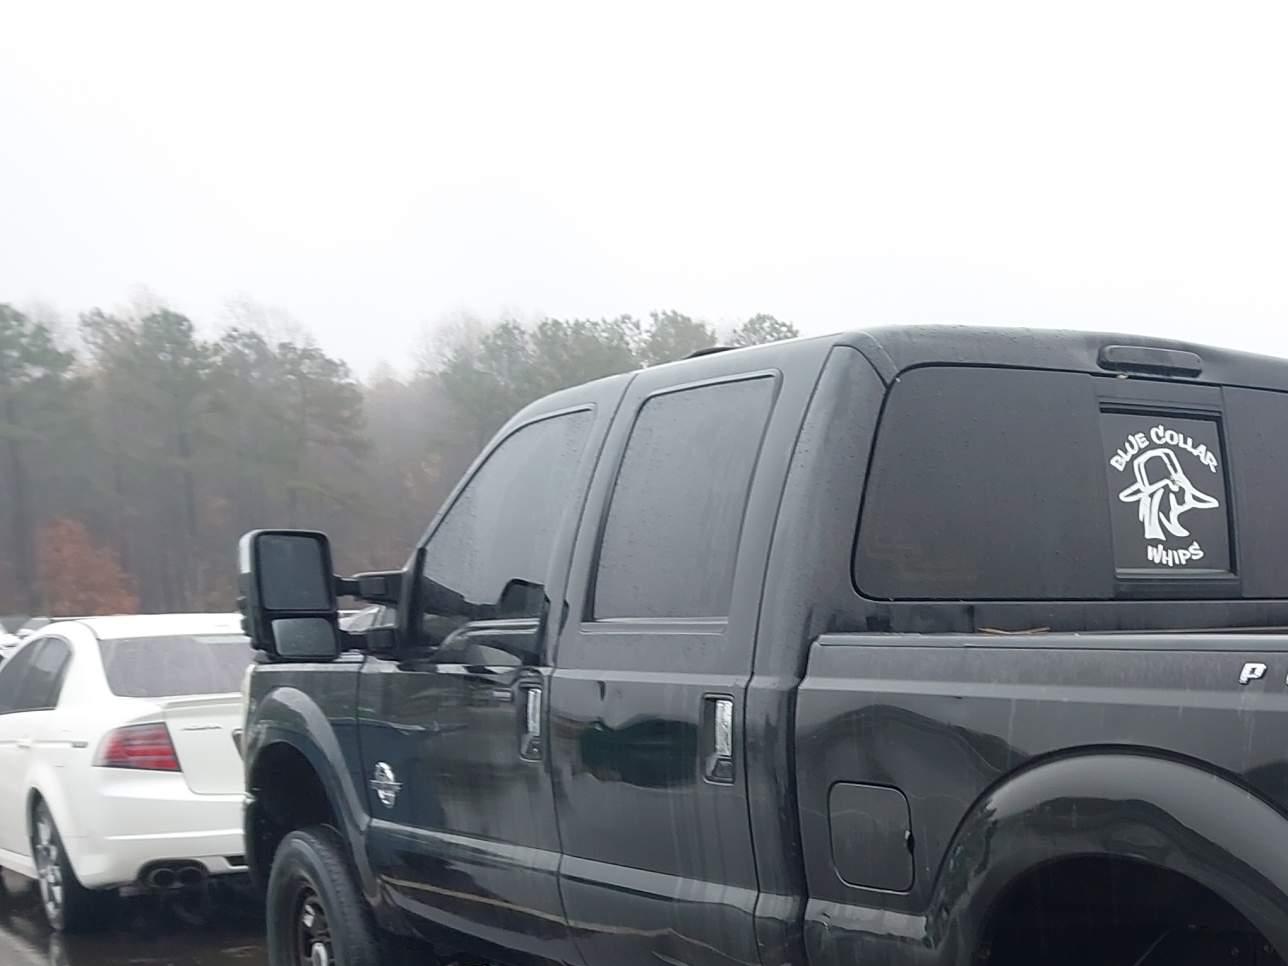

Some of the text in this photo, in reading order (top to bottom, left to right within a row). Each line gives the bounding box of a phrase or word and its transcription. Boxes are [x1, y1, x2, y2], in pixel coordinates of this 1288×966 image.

[1109, 424, 1219, 473] BLUE COLLAR
[1147, 541, 1204, 567] WHIPS
